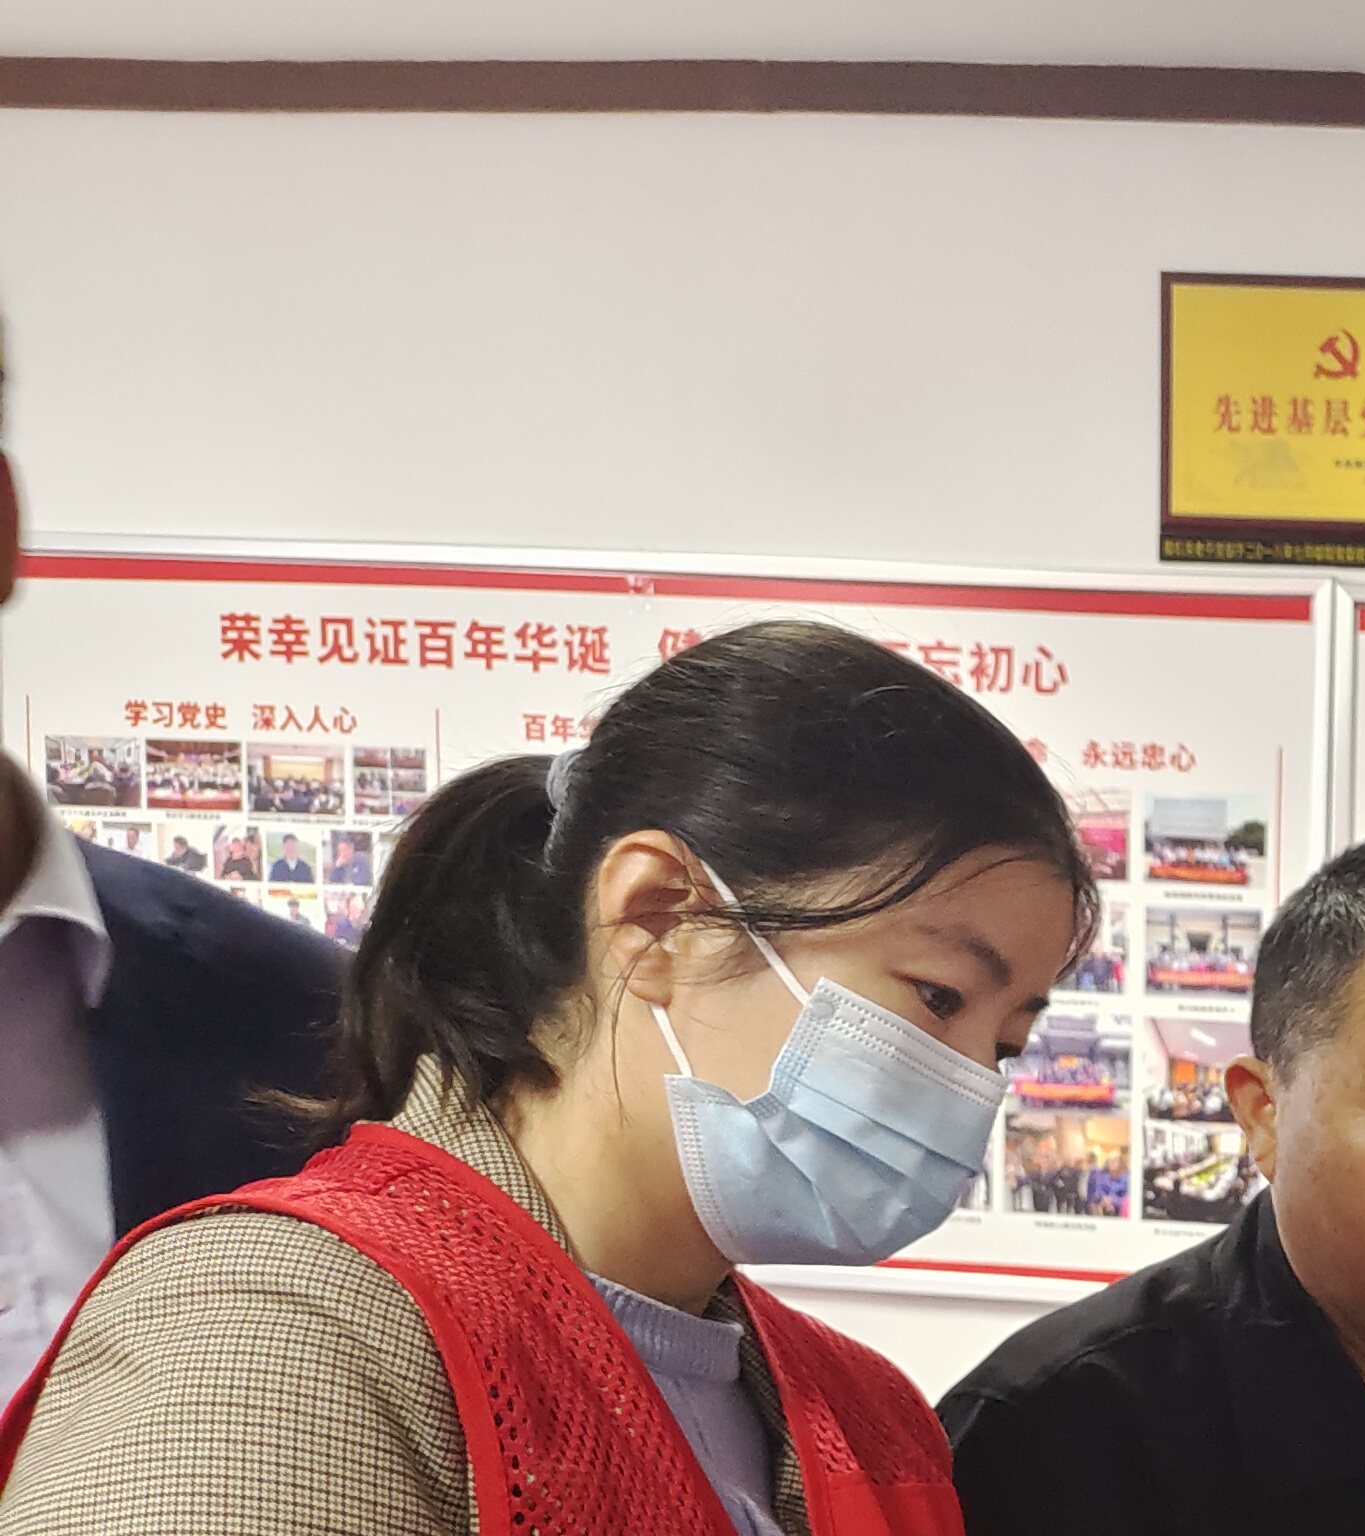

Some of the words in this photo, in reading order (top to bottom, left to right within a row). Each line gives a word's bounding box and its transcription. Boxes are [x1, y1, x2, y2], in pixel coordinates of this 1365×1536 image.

[219, 611, 610, 675] 荣幸见证百年华诞
[124, 699, 228, 731] 学习党史
[251, 703, 358, 736] 深入人心
[1082, 738, 1198, 772] 永远忠心
